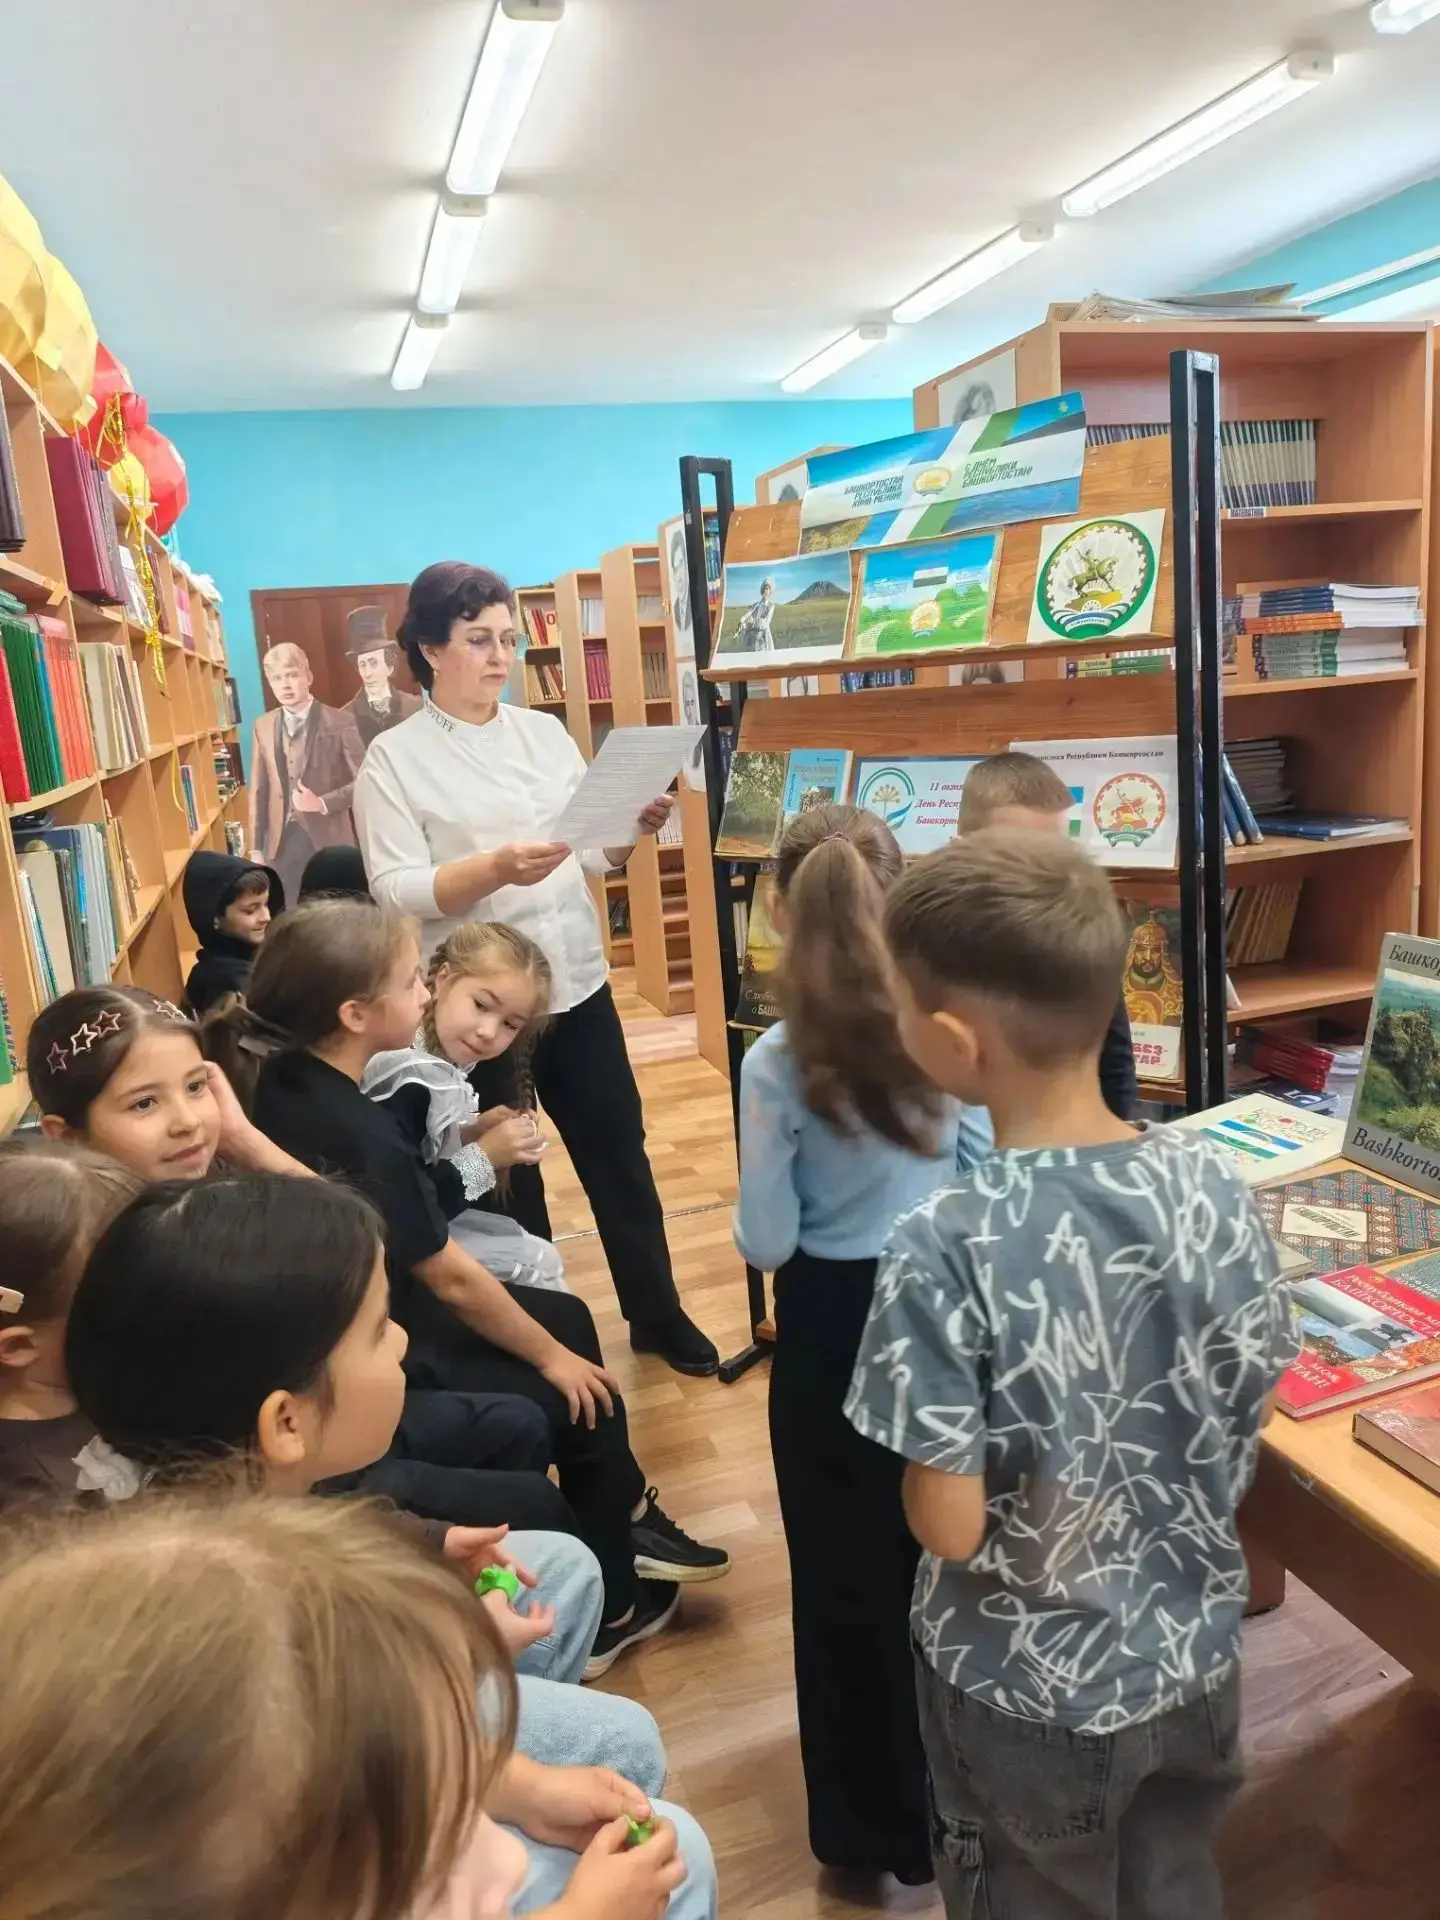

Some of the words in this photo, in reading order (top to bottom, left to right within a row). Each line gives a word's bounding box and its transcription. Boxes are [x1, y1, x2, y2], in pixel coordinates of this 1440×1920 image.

[1066, 753, 1107, 761] Республики
[1108, 751, 1164, 760] Башкортостан
[915, 799, 937, 808] День
[1352, 1126, 1440, 1182] Bashkorto
